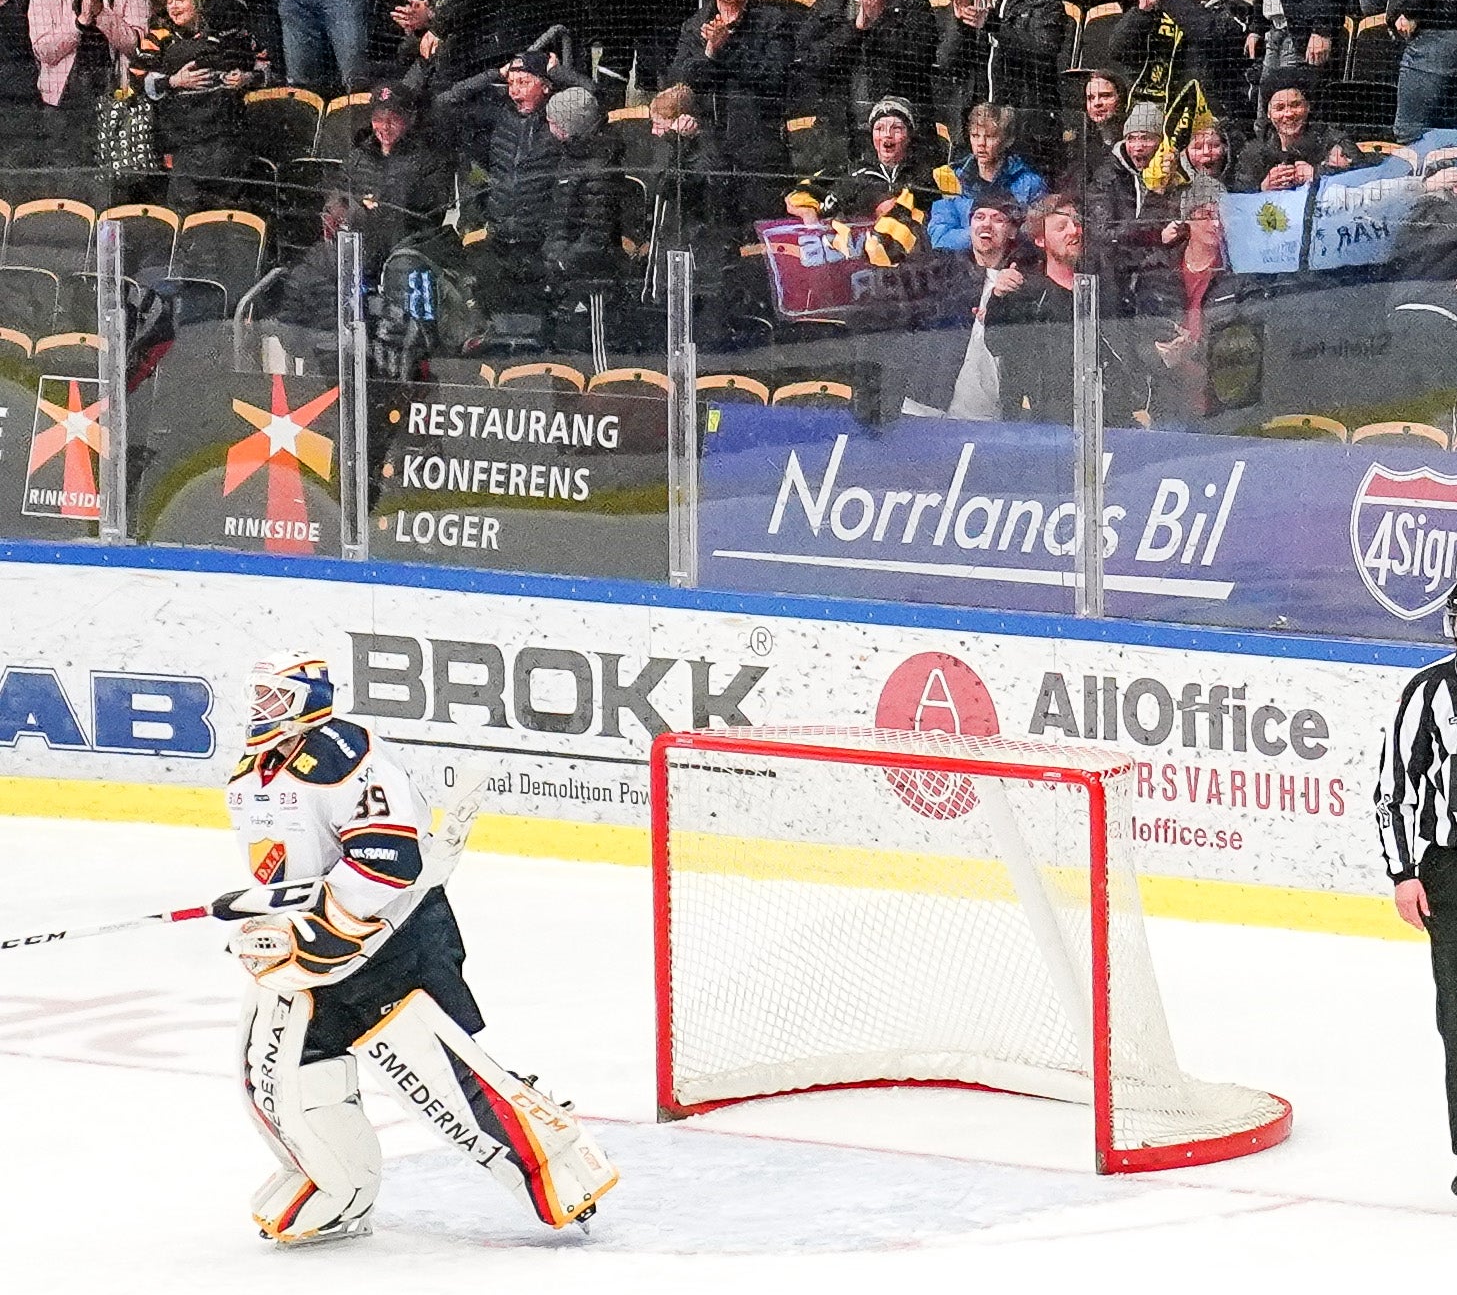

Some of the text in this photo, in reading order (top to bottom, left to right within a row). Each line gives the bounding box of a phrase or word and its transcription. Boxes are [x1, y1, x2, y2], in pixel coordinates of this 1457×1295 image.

[407, 402, 620, 450] RESTAURANG
[402, 454, 591, 502] KONFERENS
[768, 433, 1246, 570] Norrlands Bil
[224, 516, 321, 543] RINKSIDE
[395, 509, 501, 551] LOGER
[346, 631, 771, 740] BROKK
[1028, 671, 1330, 761] AllOffice
[519, 772, 613, 804] Demolition
[1137, 762, 1346, 817] RSVARUHUS
[1, 930, 68, 950] CCM
[368, 1041, 478, 1153] SMEDERNA
[510, 1092, 569, 1133] CCM
